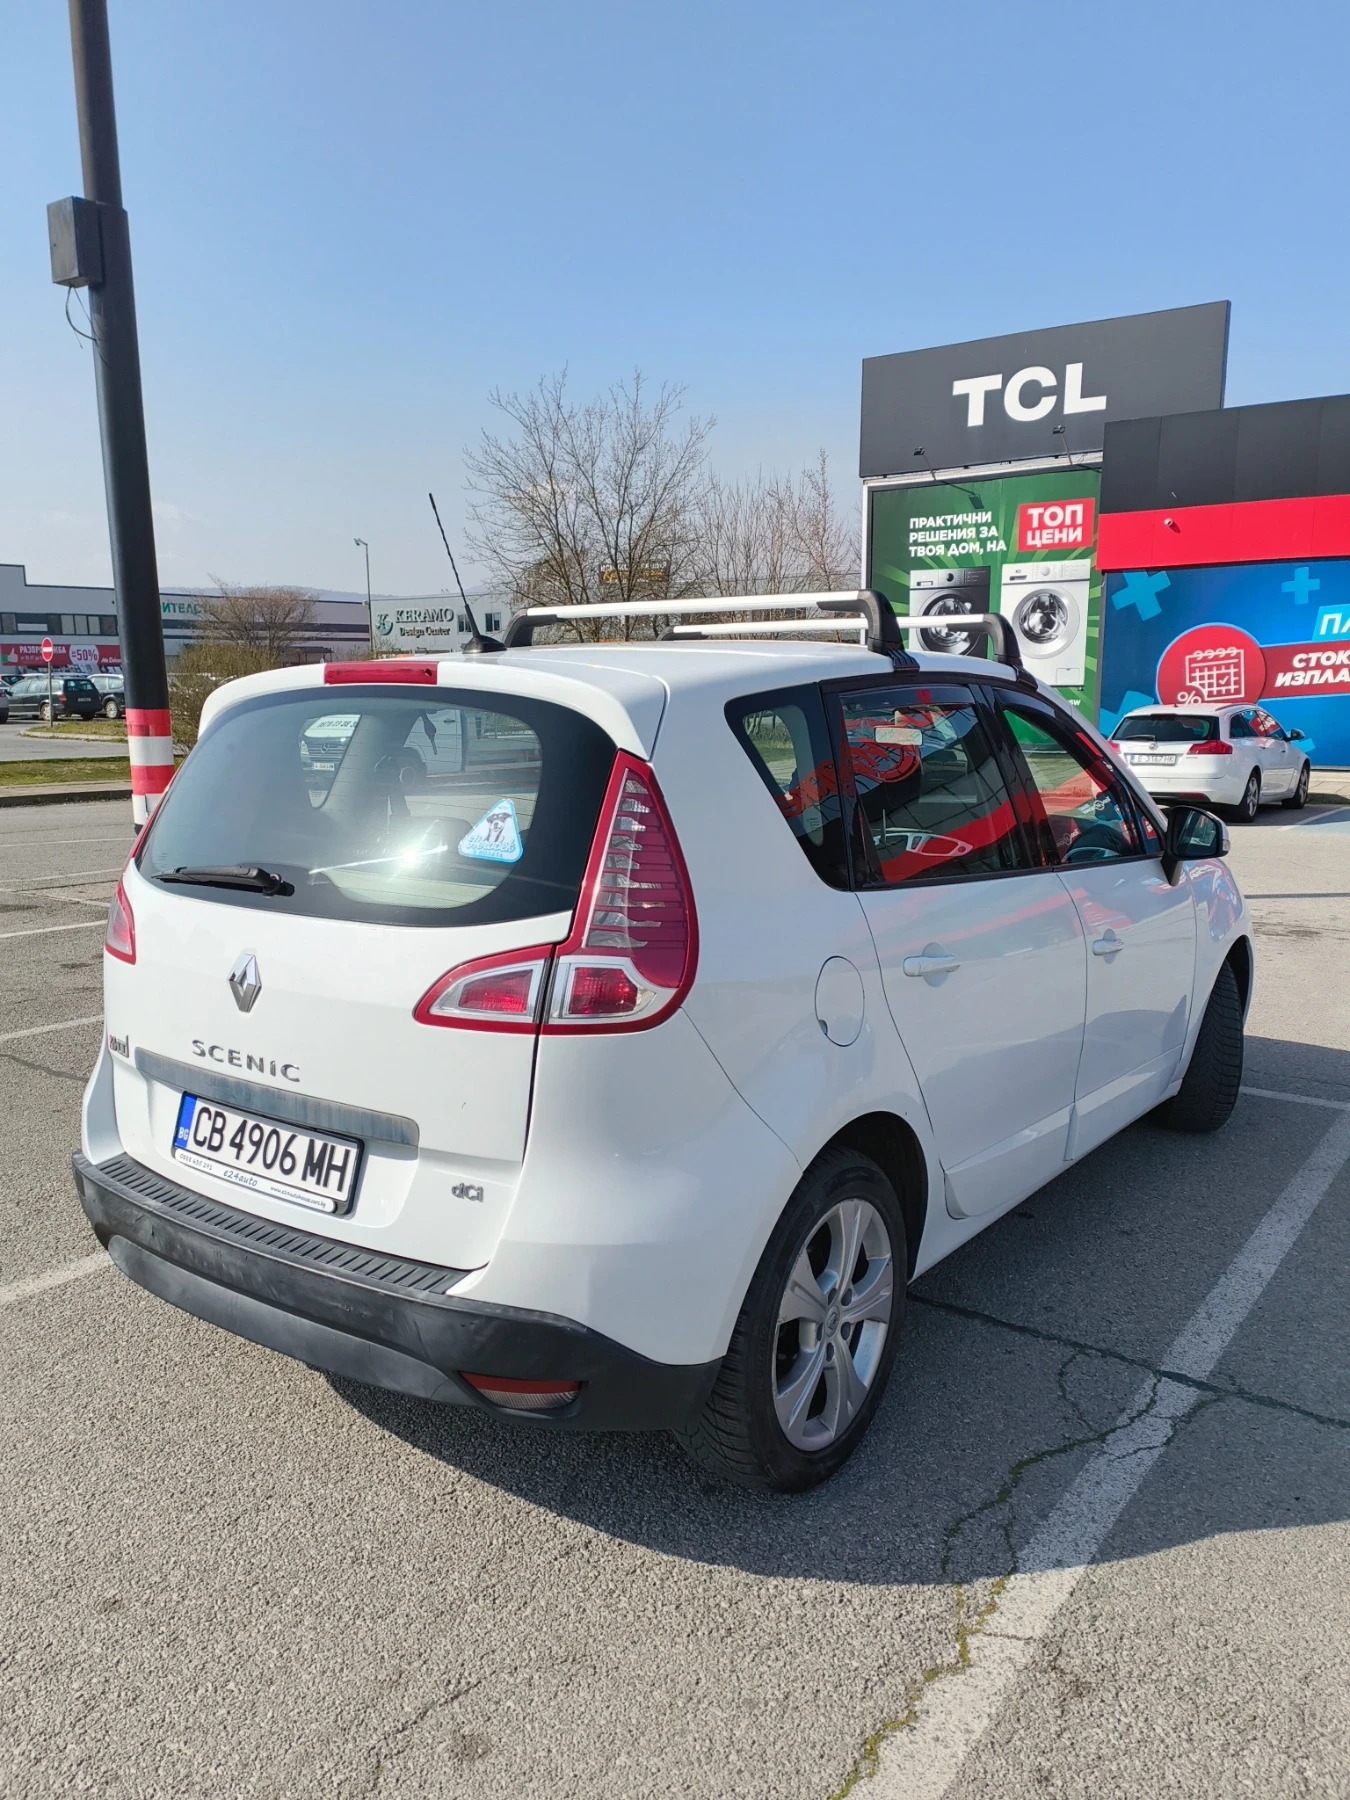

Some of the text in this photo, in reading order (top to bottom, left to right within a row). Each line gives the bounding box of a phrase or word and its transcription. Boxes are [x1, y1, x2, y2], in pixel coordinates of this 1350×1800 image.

[953, 362, 1107, 427] TCL
[909, 511, 992, 529] ПРАКТИЧНИ
[1027, 504, 1083, 528] ТОП
[909, 526, 998, 543] РЕШЕНИЯ ЗА
[1026, 527, 1082, 548] ЦЕНИ
[909, 540, 1007, 557] ТВОЯ ДОМ, НА
[395, 607, 455, 623] KERAMO
[400, 626, 451, 638] Design Center
[192, 1039, 300, 1083] SCENIC
[178, 1126, 189, 1140] BG
[193, 1106, 351, 1192] CB 4906 MH
[223, 1169, 258, 1187] e24auto
